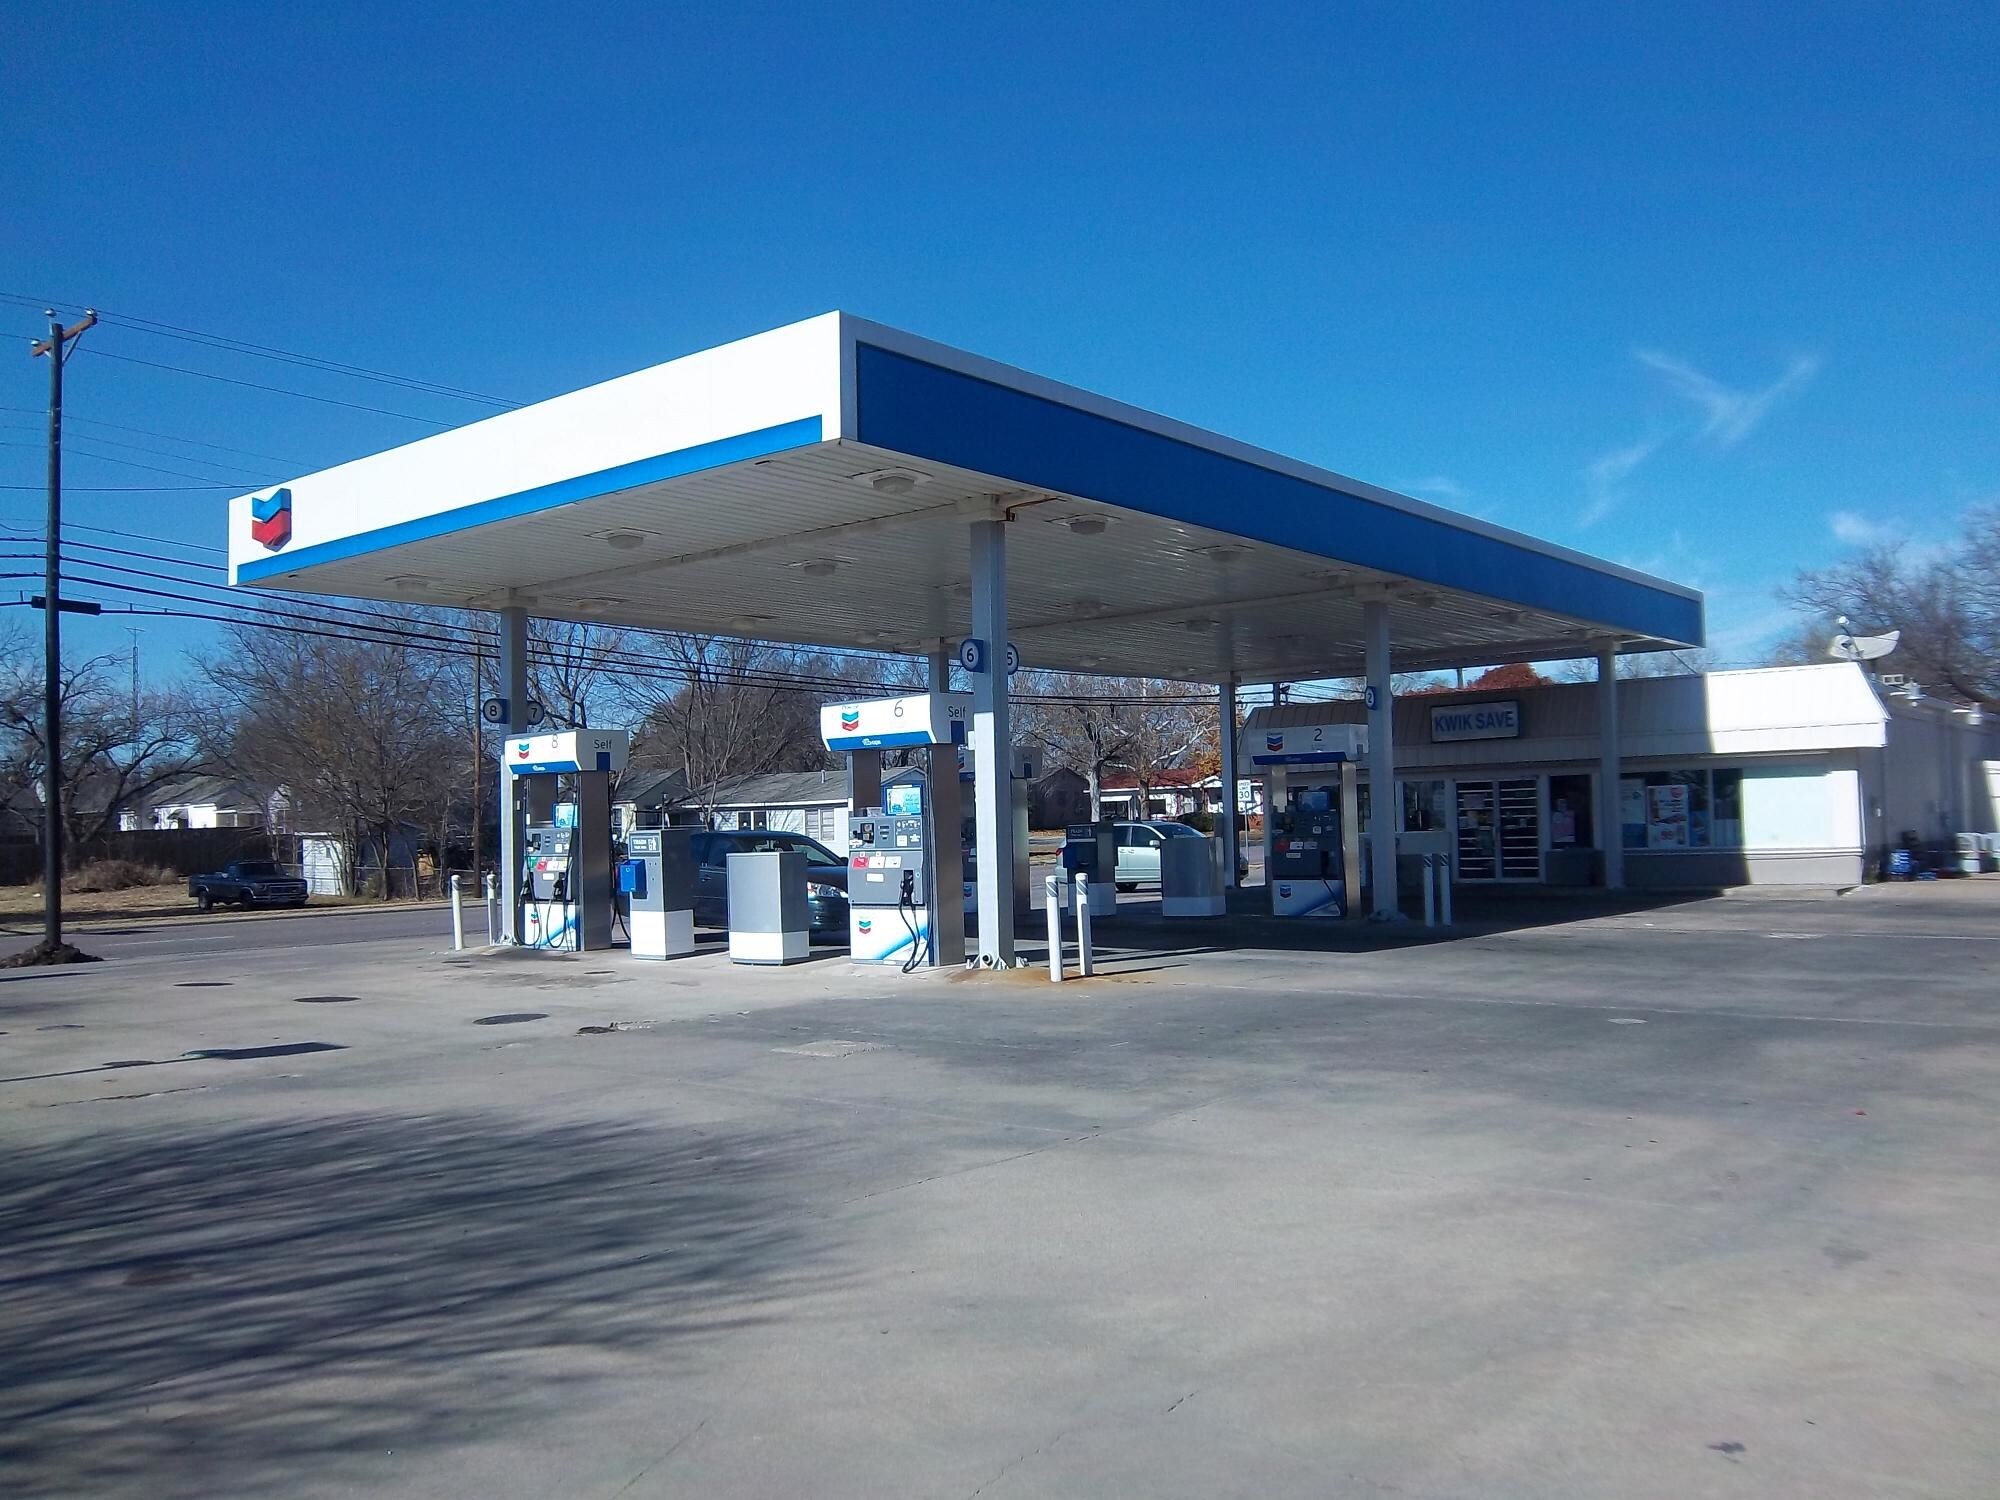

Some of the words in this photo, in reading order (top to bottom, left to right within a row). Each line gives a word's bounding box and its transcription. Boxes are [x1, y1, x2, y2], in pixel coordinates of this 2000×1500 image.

[966, 647, 975, 663] 6
[489, 705, 498, 717] 8
[893, 699, 904, 718] 6
[948, 705, 967, 719] Self
[1434, 713, 1473, 732] KWIK
[1475, 710, 1515, 730] SAVE
[1313, 727, 1323, 742] 2
[593, 738, 612, 750] Self
[1238, 790, 1250, 799] 30
